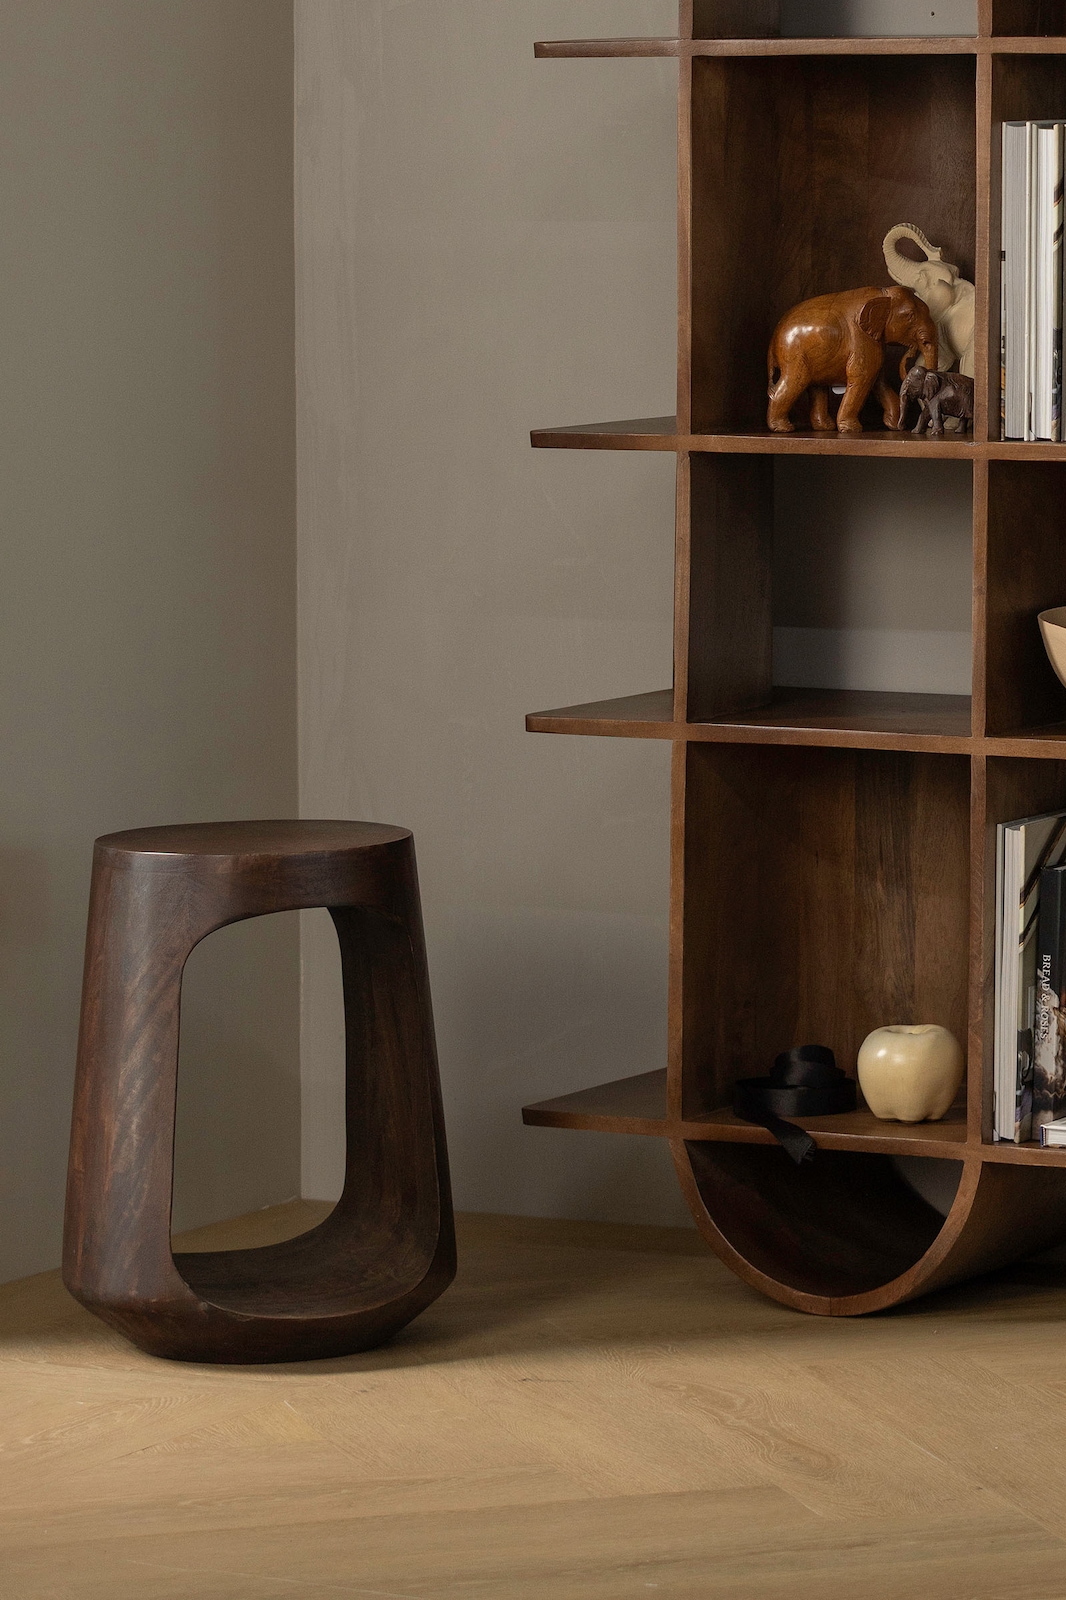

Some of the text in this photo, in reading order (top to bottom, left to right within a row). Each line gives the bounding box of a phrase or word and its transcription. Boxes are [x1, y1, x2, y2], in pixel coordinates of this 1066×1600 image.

[1040, 954, 1051, 1040] BREAD & ROSES
